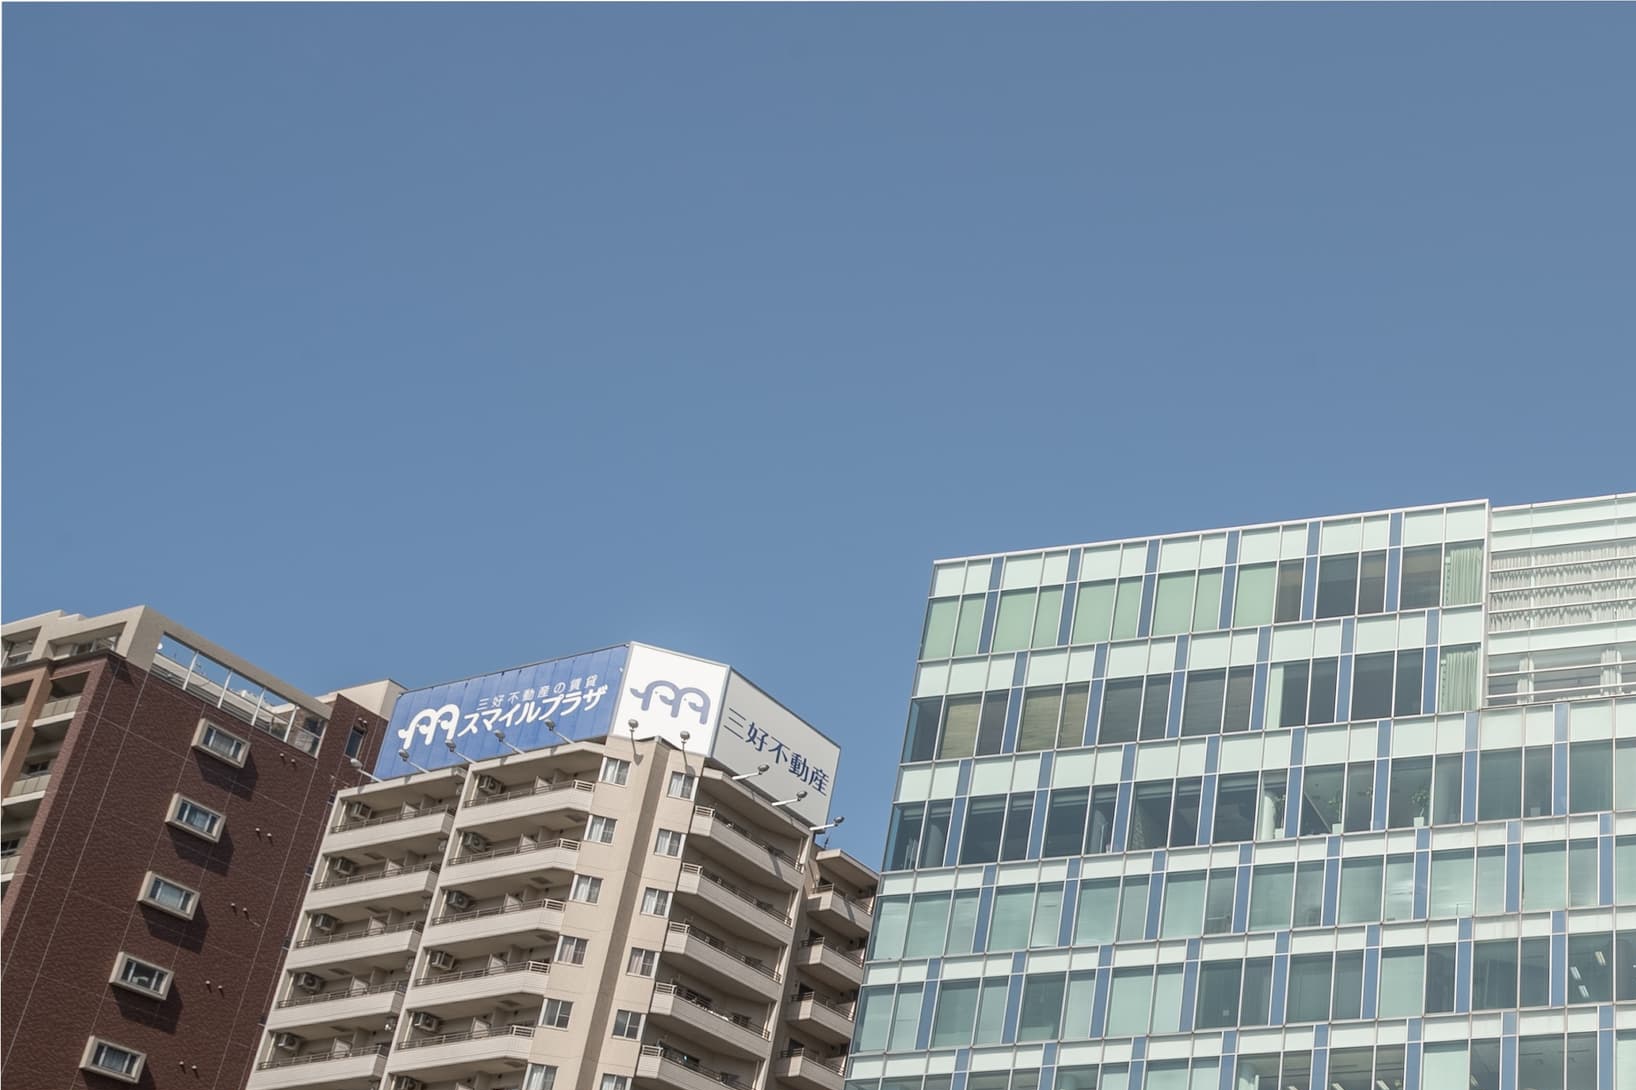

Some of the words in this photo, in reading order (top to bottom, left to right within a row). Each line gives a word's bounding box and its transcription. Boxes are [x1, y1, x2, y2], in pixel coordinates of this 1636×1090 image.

[457, 684, 609, 737] スマイルプラザ
[476, 674, 599, 711] 三好不動産の賃貸
[723, 707, 829, 796] 三好不動産
